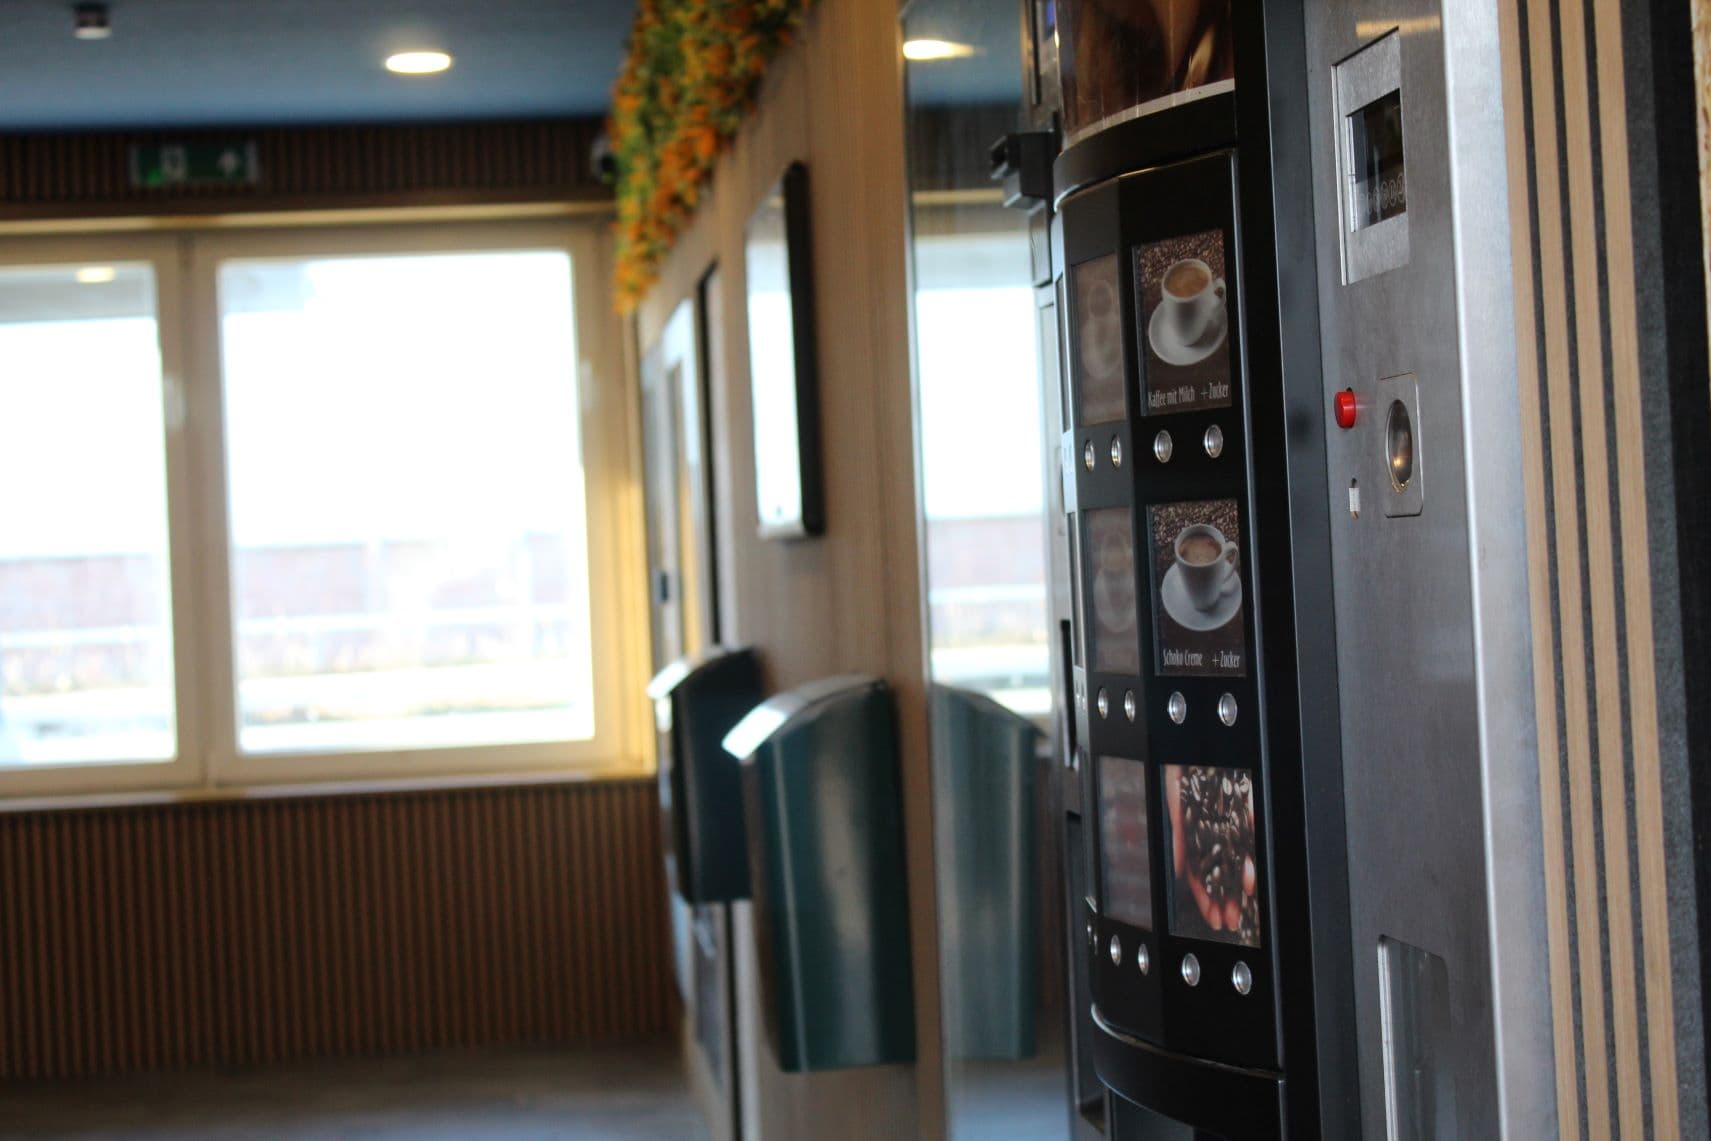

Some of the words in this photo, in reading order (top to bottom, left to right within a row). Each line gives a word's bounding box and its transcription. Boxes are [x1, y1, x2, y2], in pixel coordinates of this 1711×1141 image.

[1148, 389, 1167, 409] Kaffee
[1167, 388, 1178, 405] mit
[1178, 385, 1195, 404] Milch
[1163, 648, 1183, 667] Schoko
[1184, 649, 1203, 667] Creme
